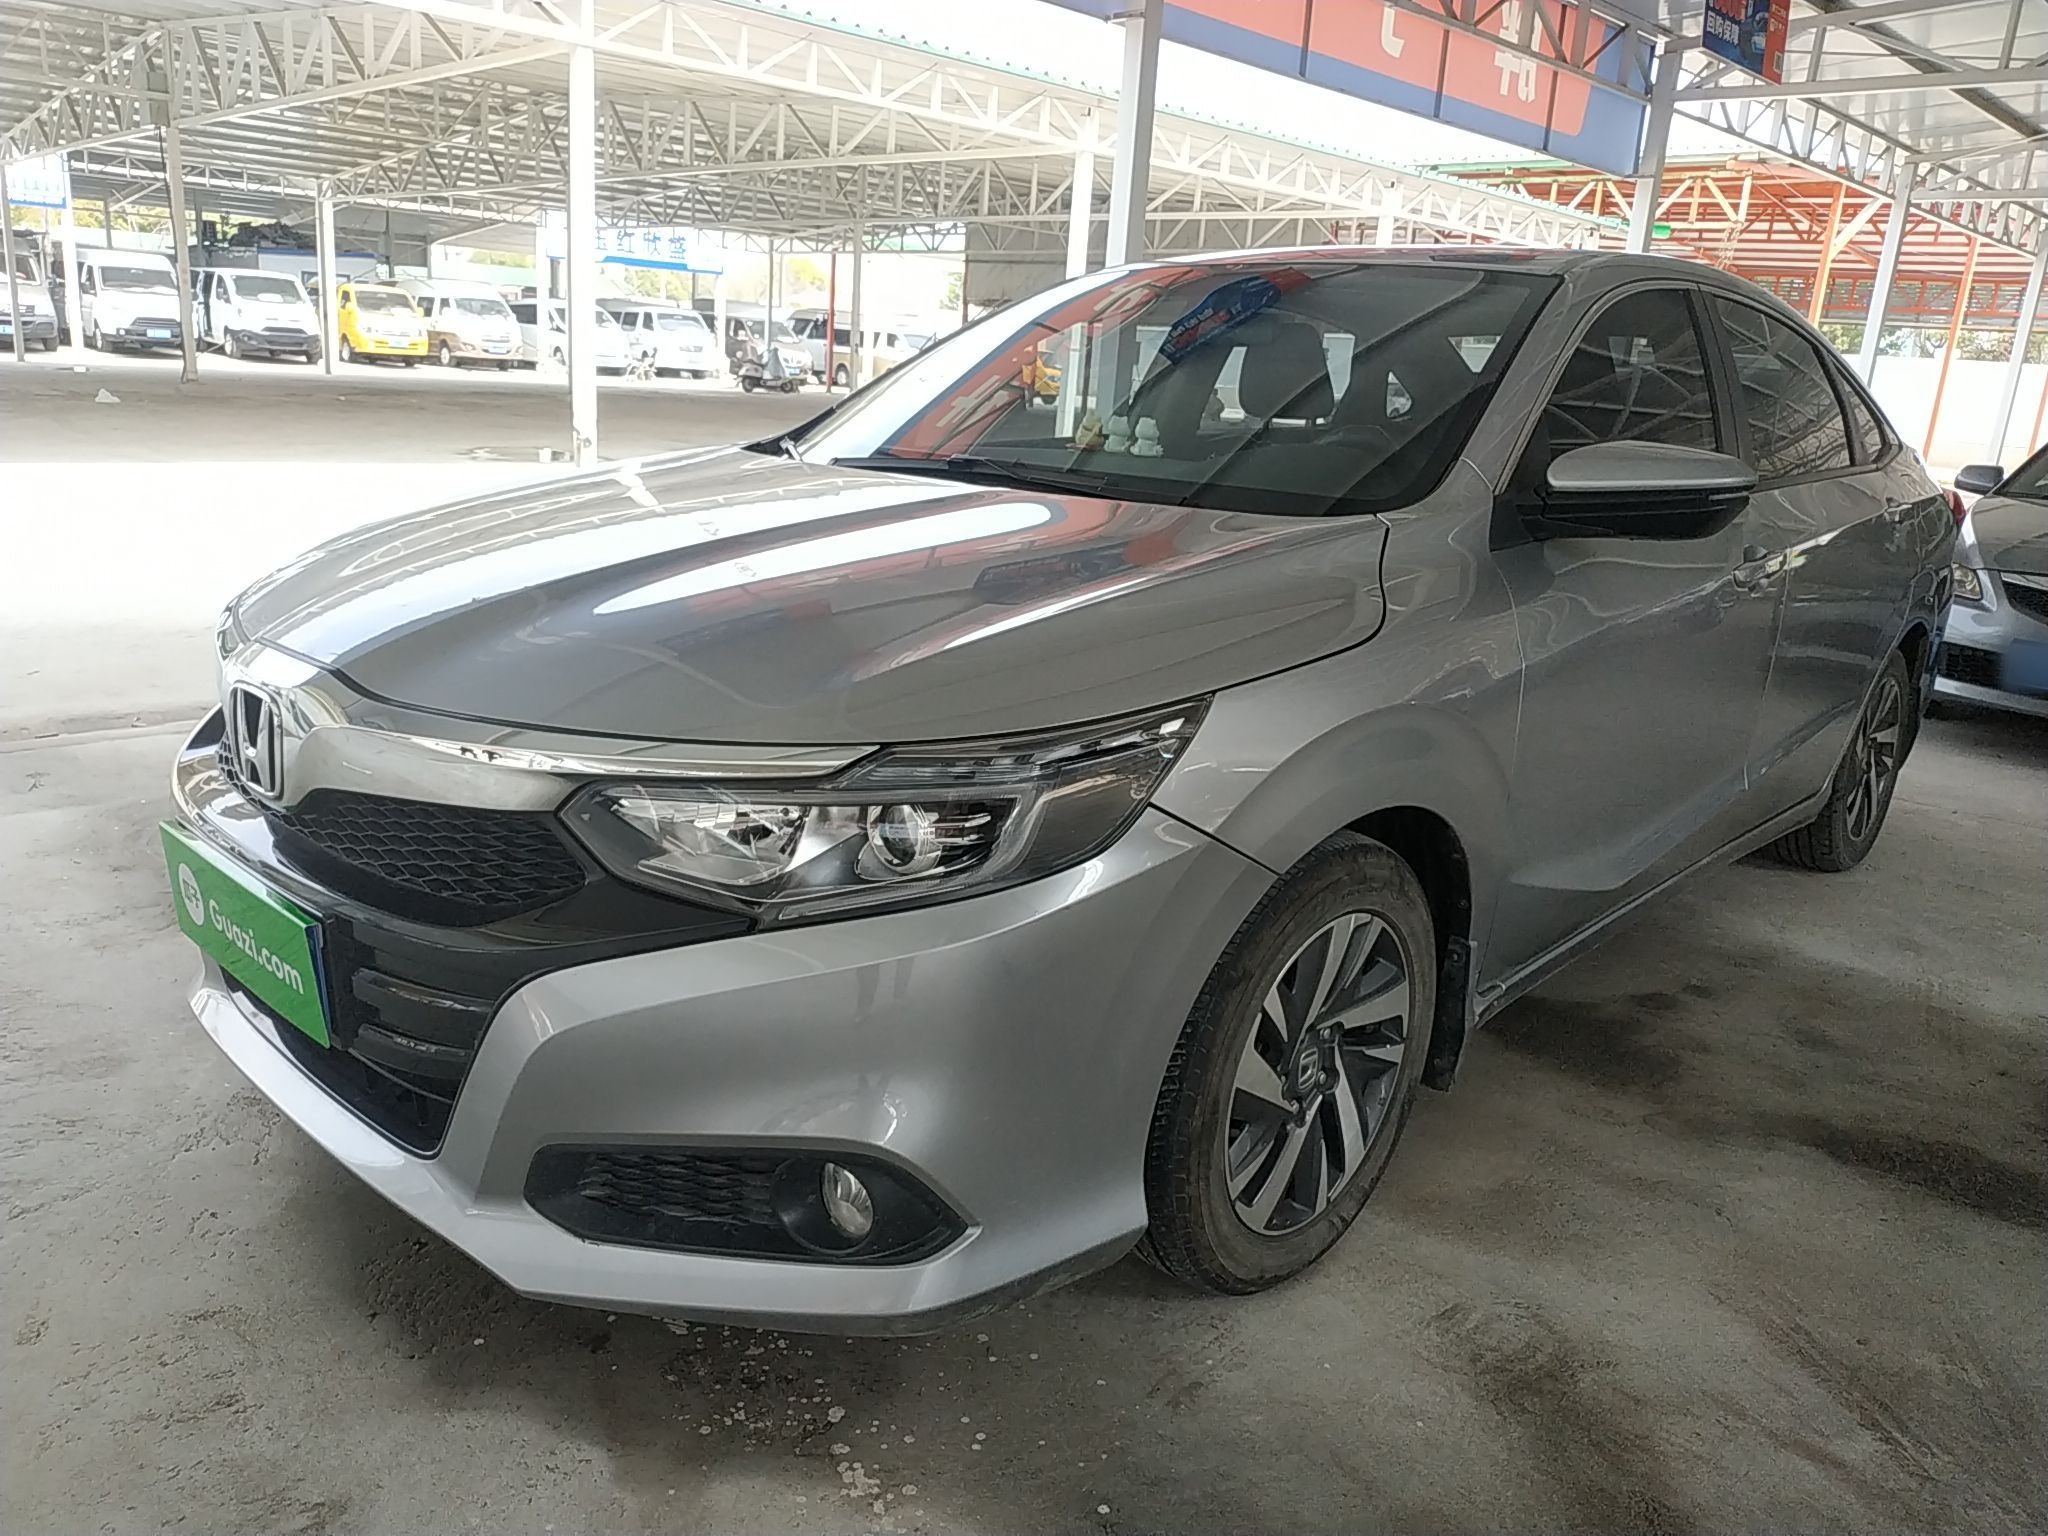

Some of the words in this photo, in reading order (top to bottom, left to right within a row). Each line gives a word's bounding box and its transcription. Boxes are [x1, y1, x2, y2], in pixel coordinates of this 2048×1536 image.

[1706, 11, 1740, 45] 回购保障
[208, 898, 304, 995] Guazi.com
